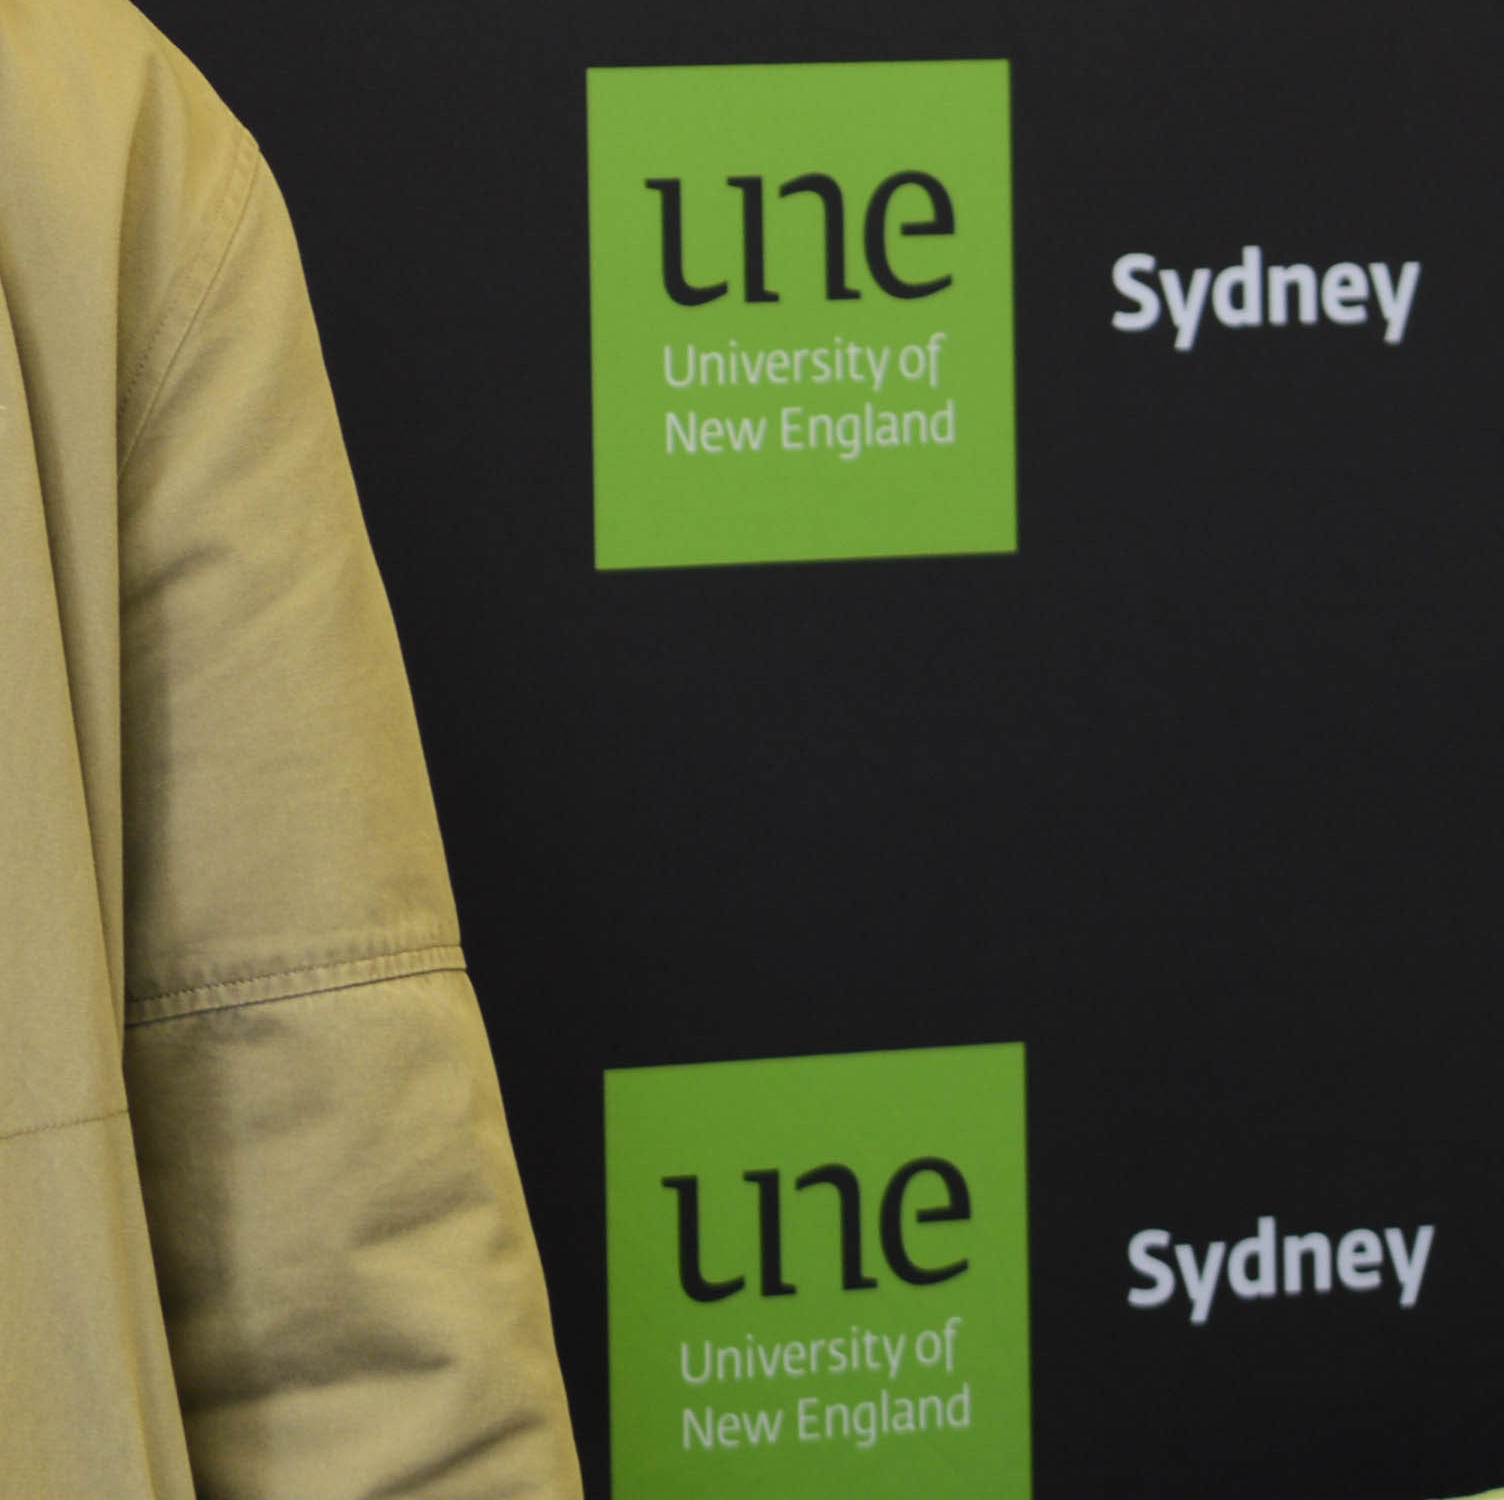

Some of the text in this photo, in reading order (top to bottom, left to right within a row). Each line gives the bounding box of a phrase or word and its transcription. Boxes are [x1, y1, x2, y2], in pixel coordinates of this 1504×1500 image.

[644, 170, 956, 308] une
[1113, 246, 1419, 350] Sydney
[663, 331, 946, 392] University of
[665, 400, 957, 462] New England
[659, 1155, 974, 1305] une
[1128, 1216, 1434, 1323] Sydney
[680, 1317, 963, 1385] University of
[682, 1382, 972, 1450] New England
